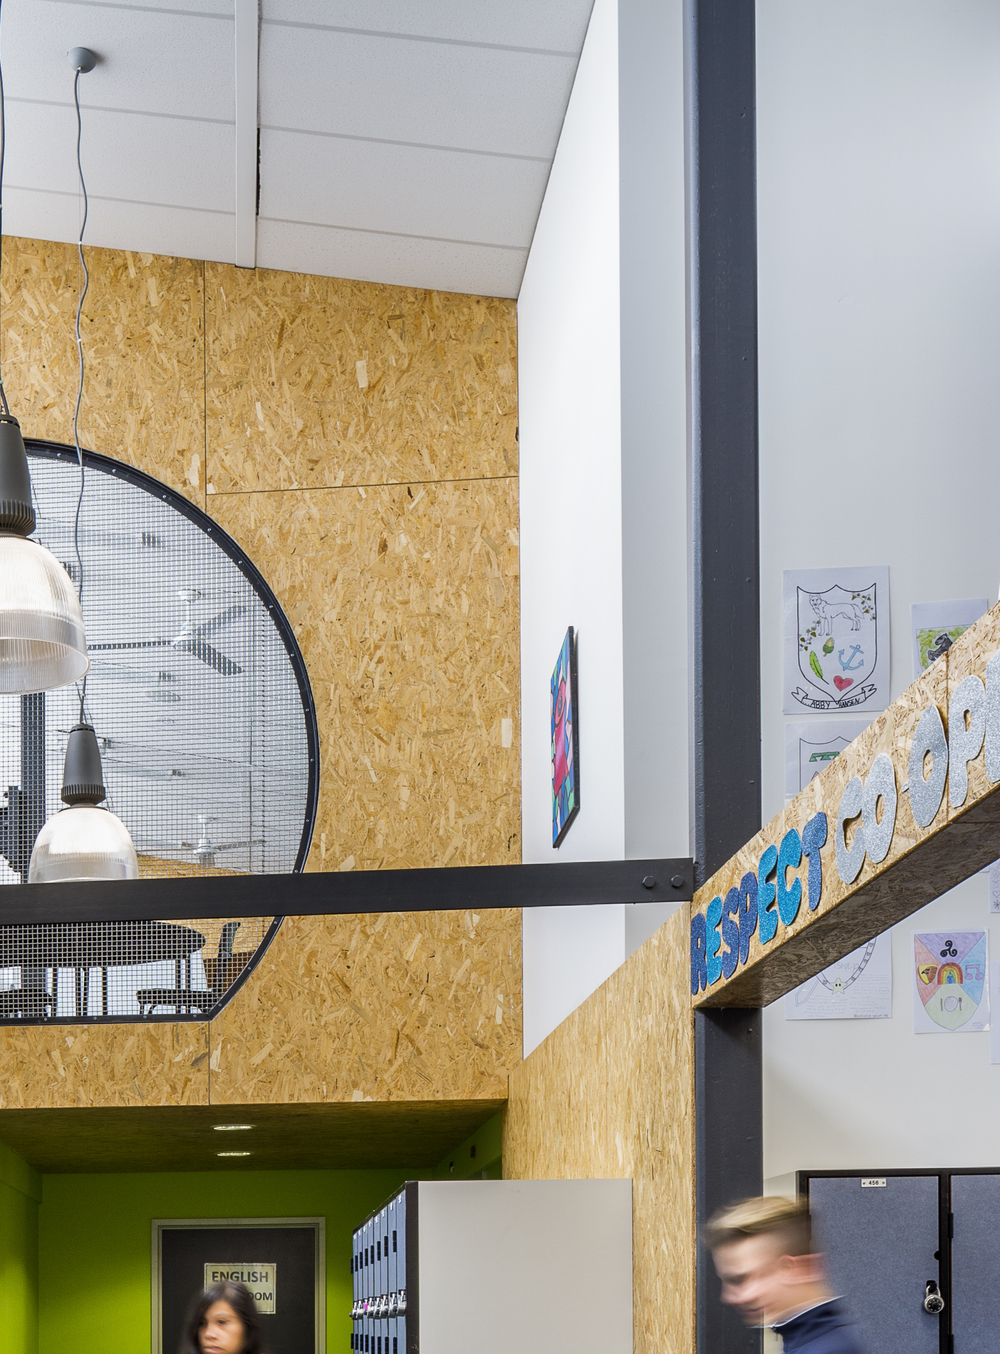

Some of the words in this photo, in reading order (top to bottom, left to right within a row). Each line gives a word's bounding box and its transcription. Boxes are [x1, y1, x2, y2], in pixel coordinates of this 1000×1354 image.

[810, 700, 831, 710] ABBY
[691, 812, 828, 996] RESPECT
[835, 648, 1000, 885] CO-OP
[211, 1271, 269, 1283] ENGLISH
